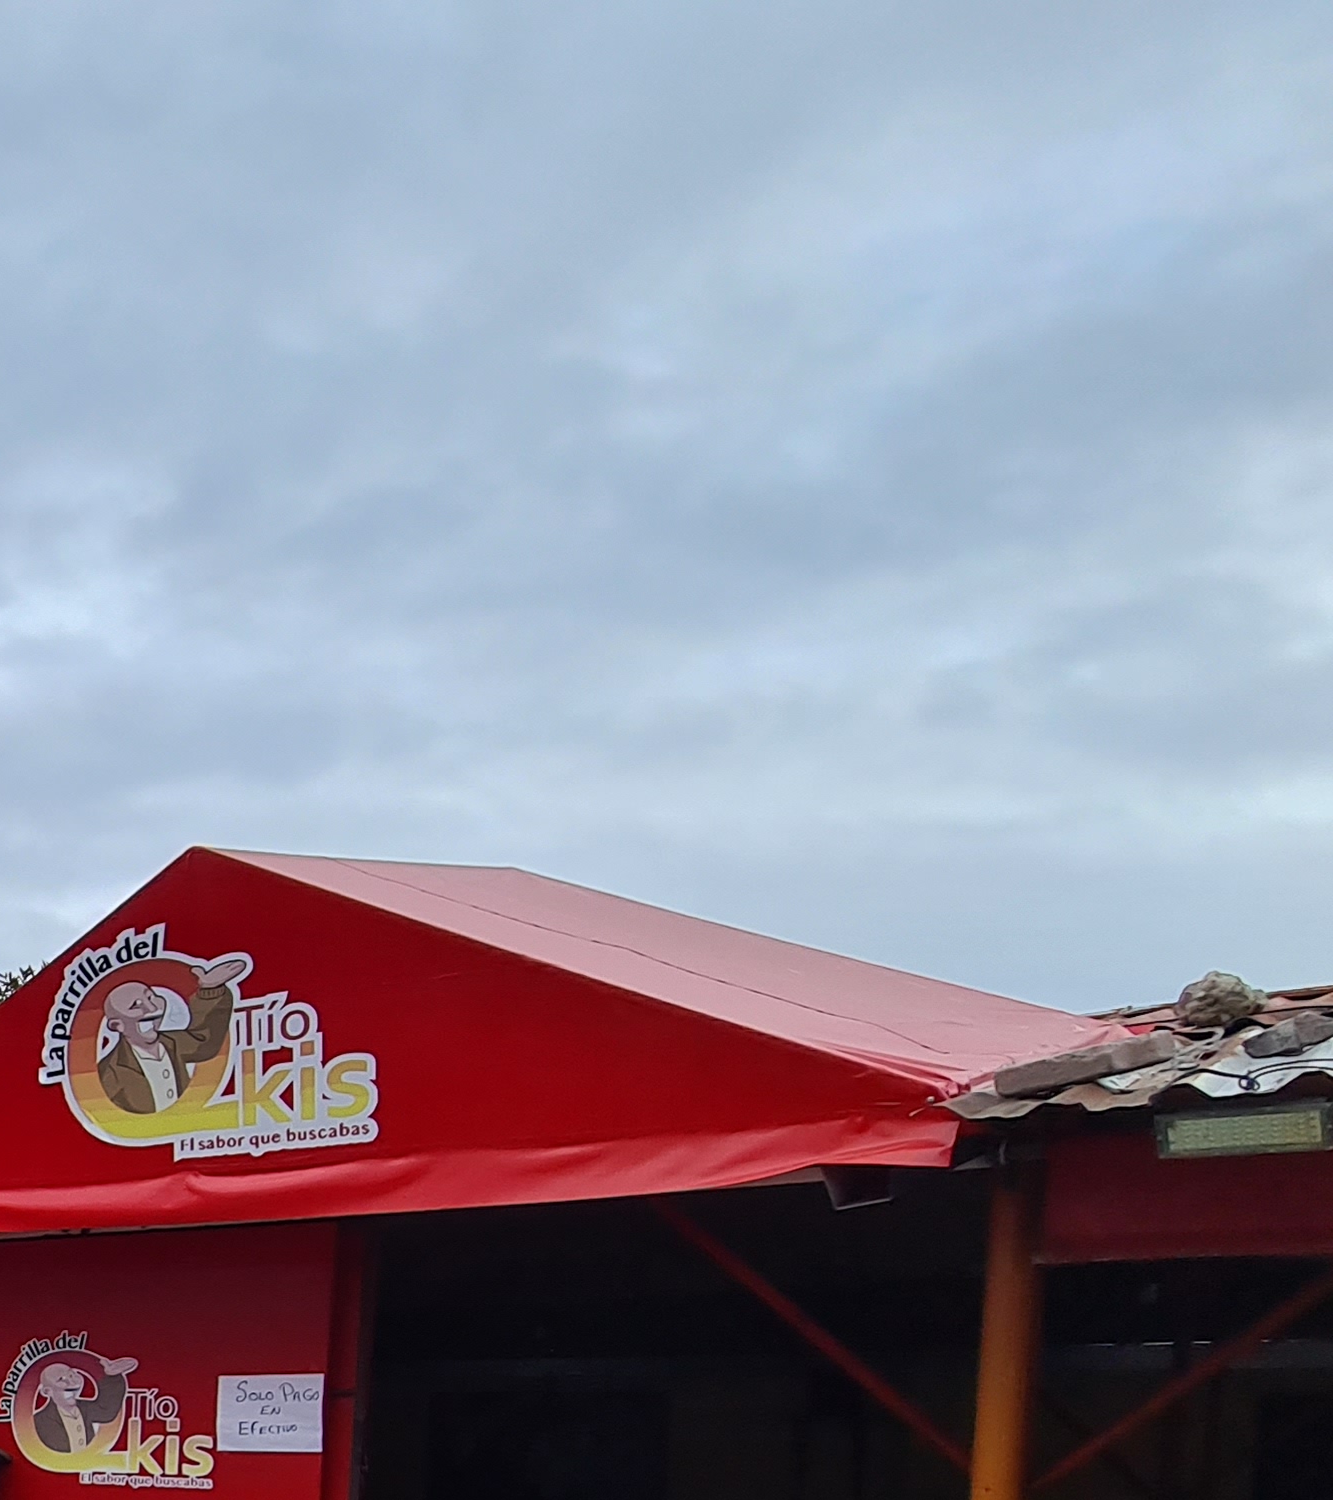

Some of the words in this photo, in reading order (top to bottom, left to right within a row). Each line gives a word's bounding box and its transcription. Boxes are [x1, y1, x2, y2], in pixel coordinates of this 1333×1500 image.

[116, 932, 159, 964] del
[51, 954, 113, 1040] parrilla
[234, 1000, 310, 1047] Tío
[46, 1045, 65, 1078] La
[198, 1135, 245, 1151] sabor
[249, 1132, 282, 1148] que
[286, 1122, 371, 1142] buscabas
[3, 1340, 51, 1395] parrilla
[56, 1332, 86, 1350] del
[128, 1389, 177, 1419] Tío
[94, 1474, 126, 1484] sabor
[130, 1477, 153, 1487] que
[155, 1476, 212, 1488] buscabas
